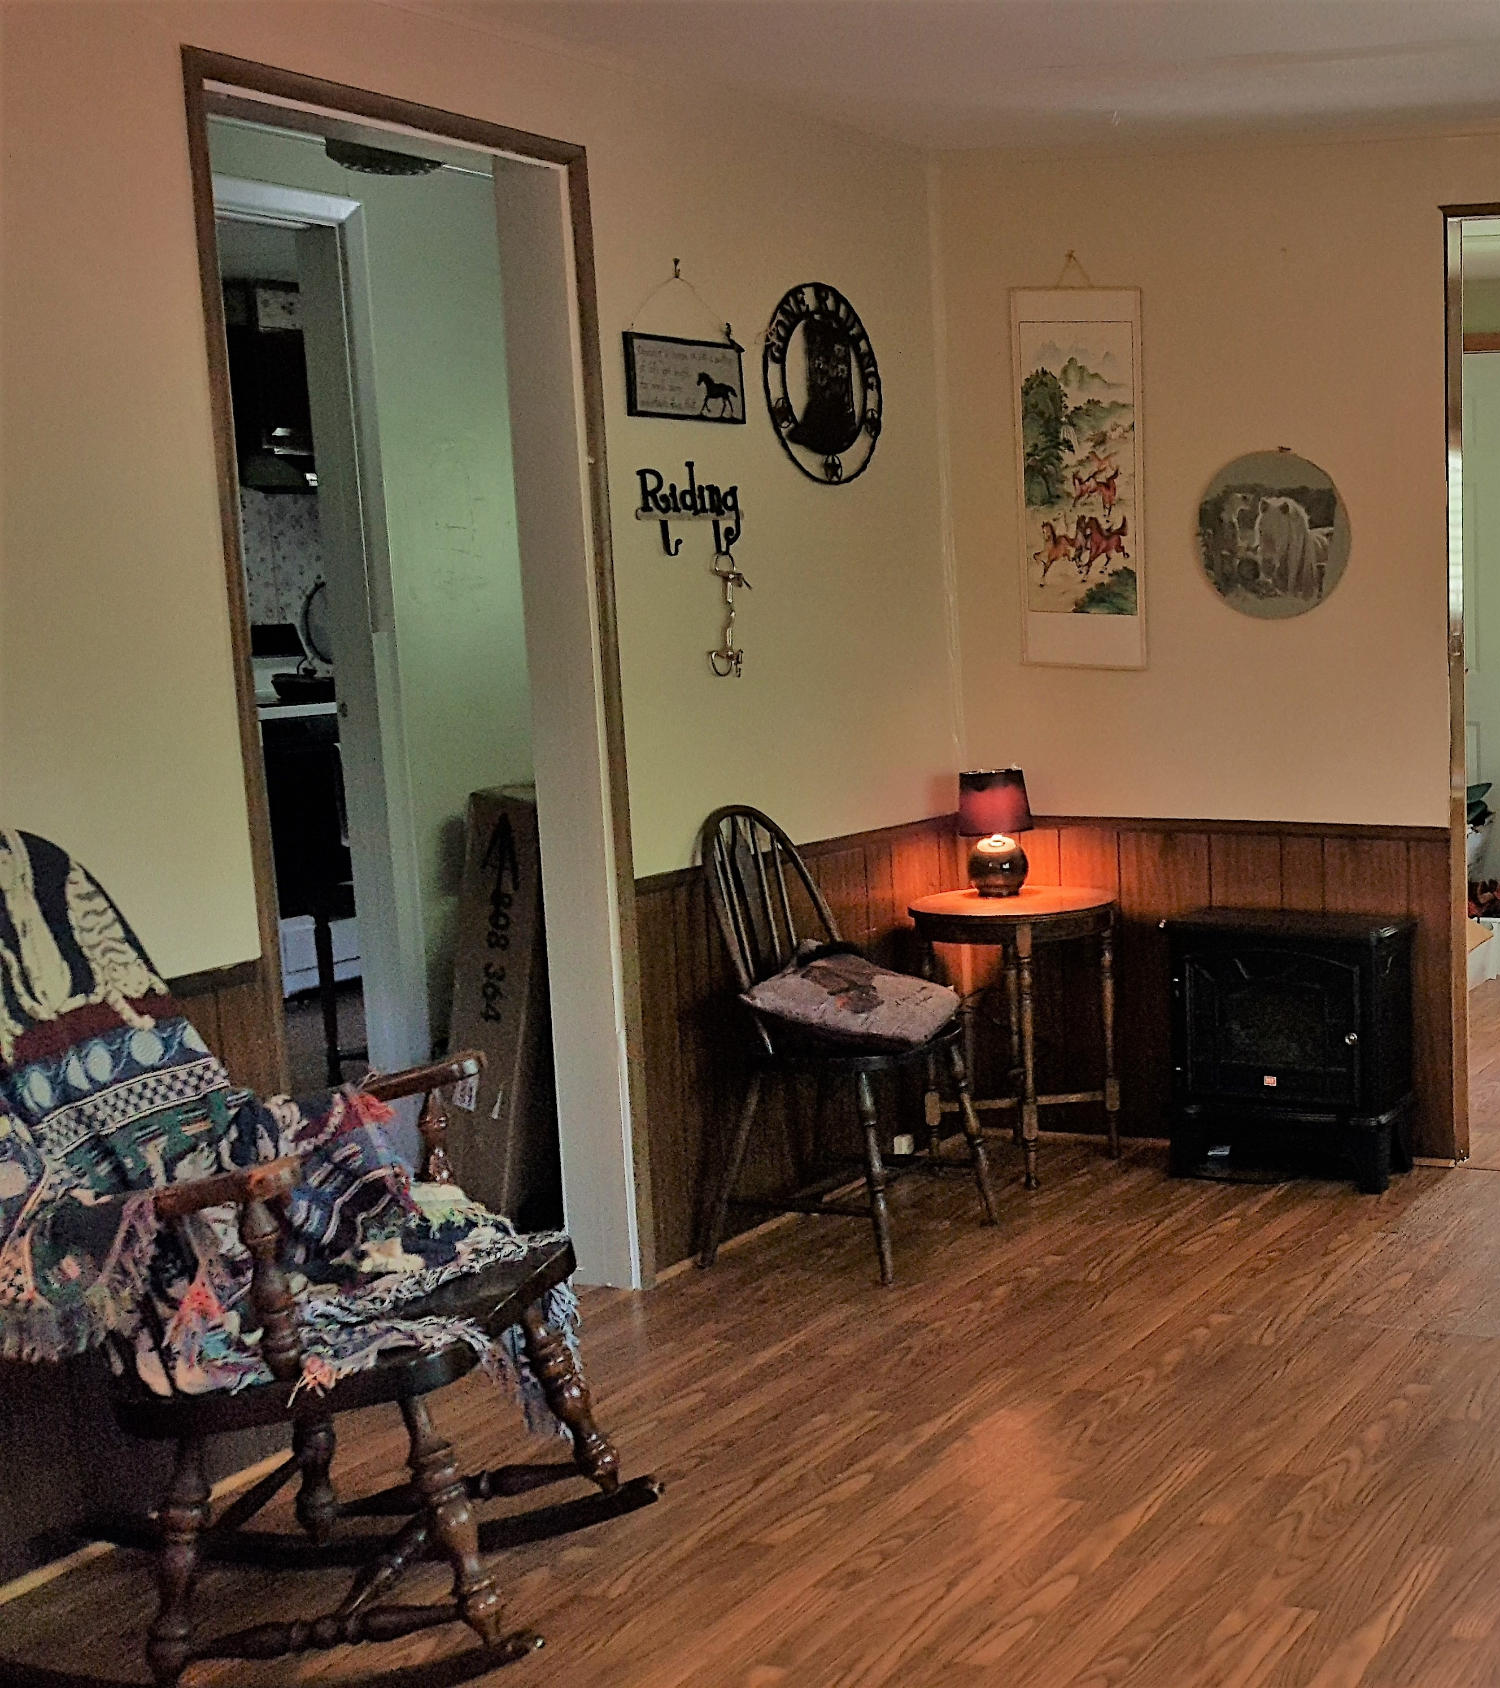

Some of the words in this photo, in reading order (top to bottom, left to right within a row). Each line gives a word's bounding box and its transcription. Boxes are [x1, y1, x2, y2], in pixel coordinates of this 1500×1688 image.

[767, 288, 809, 362] GONE
[814, 287, 878, 390] RIDING
[636, 461, 742, 544] Riding
